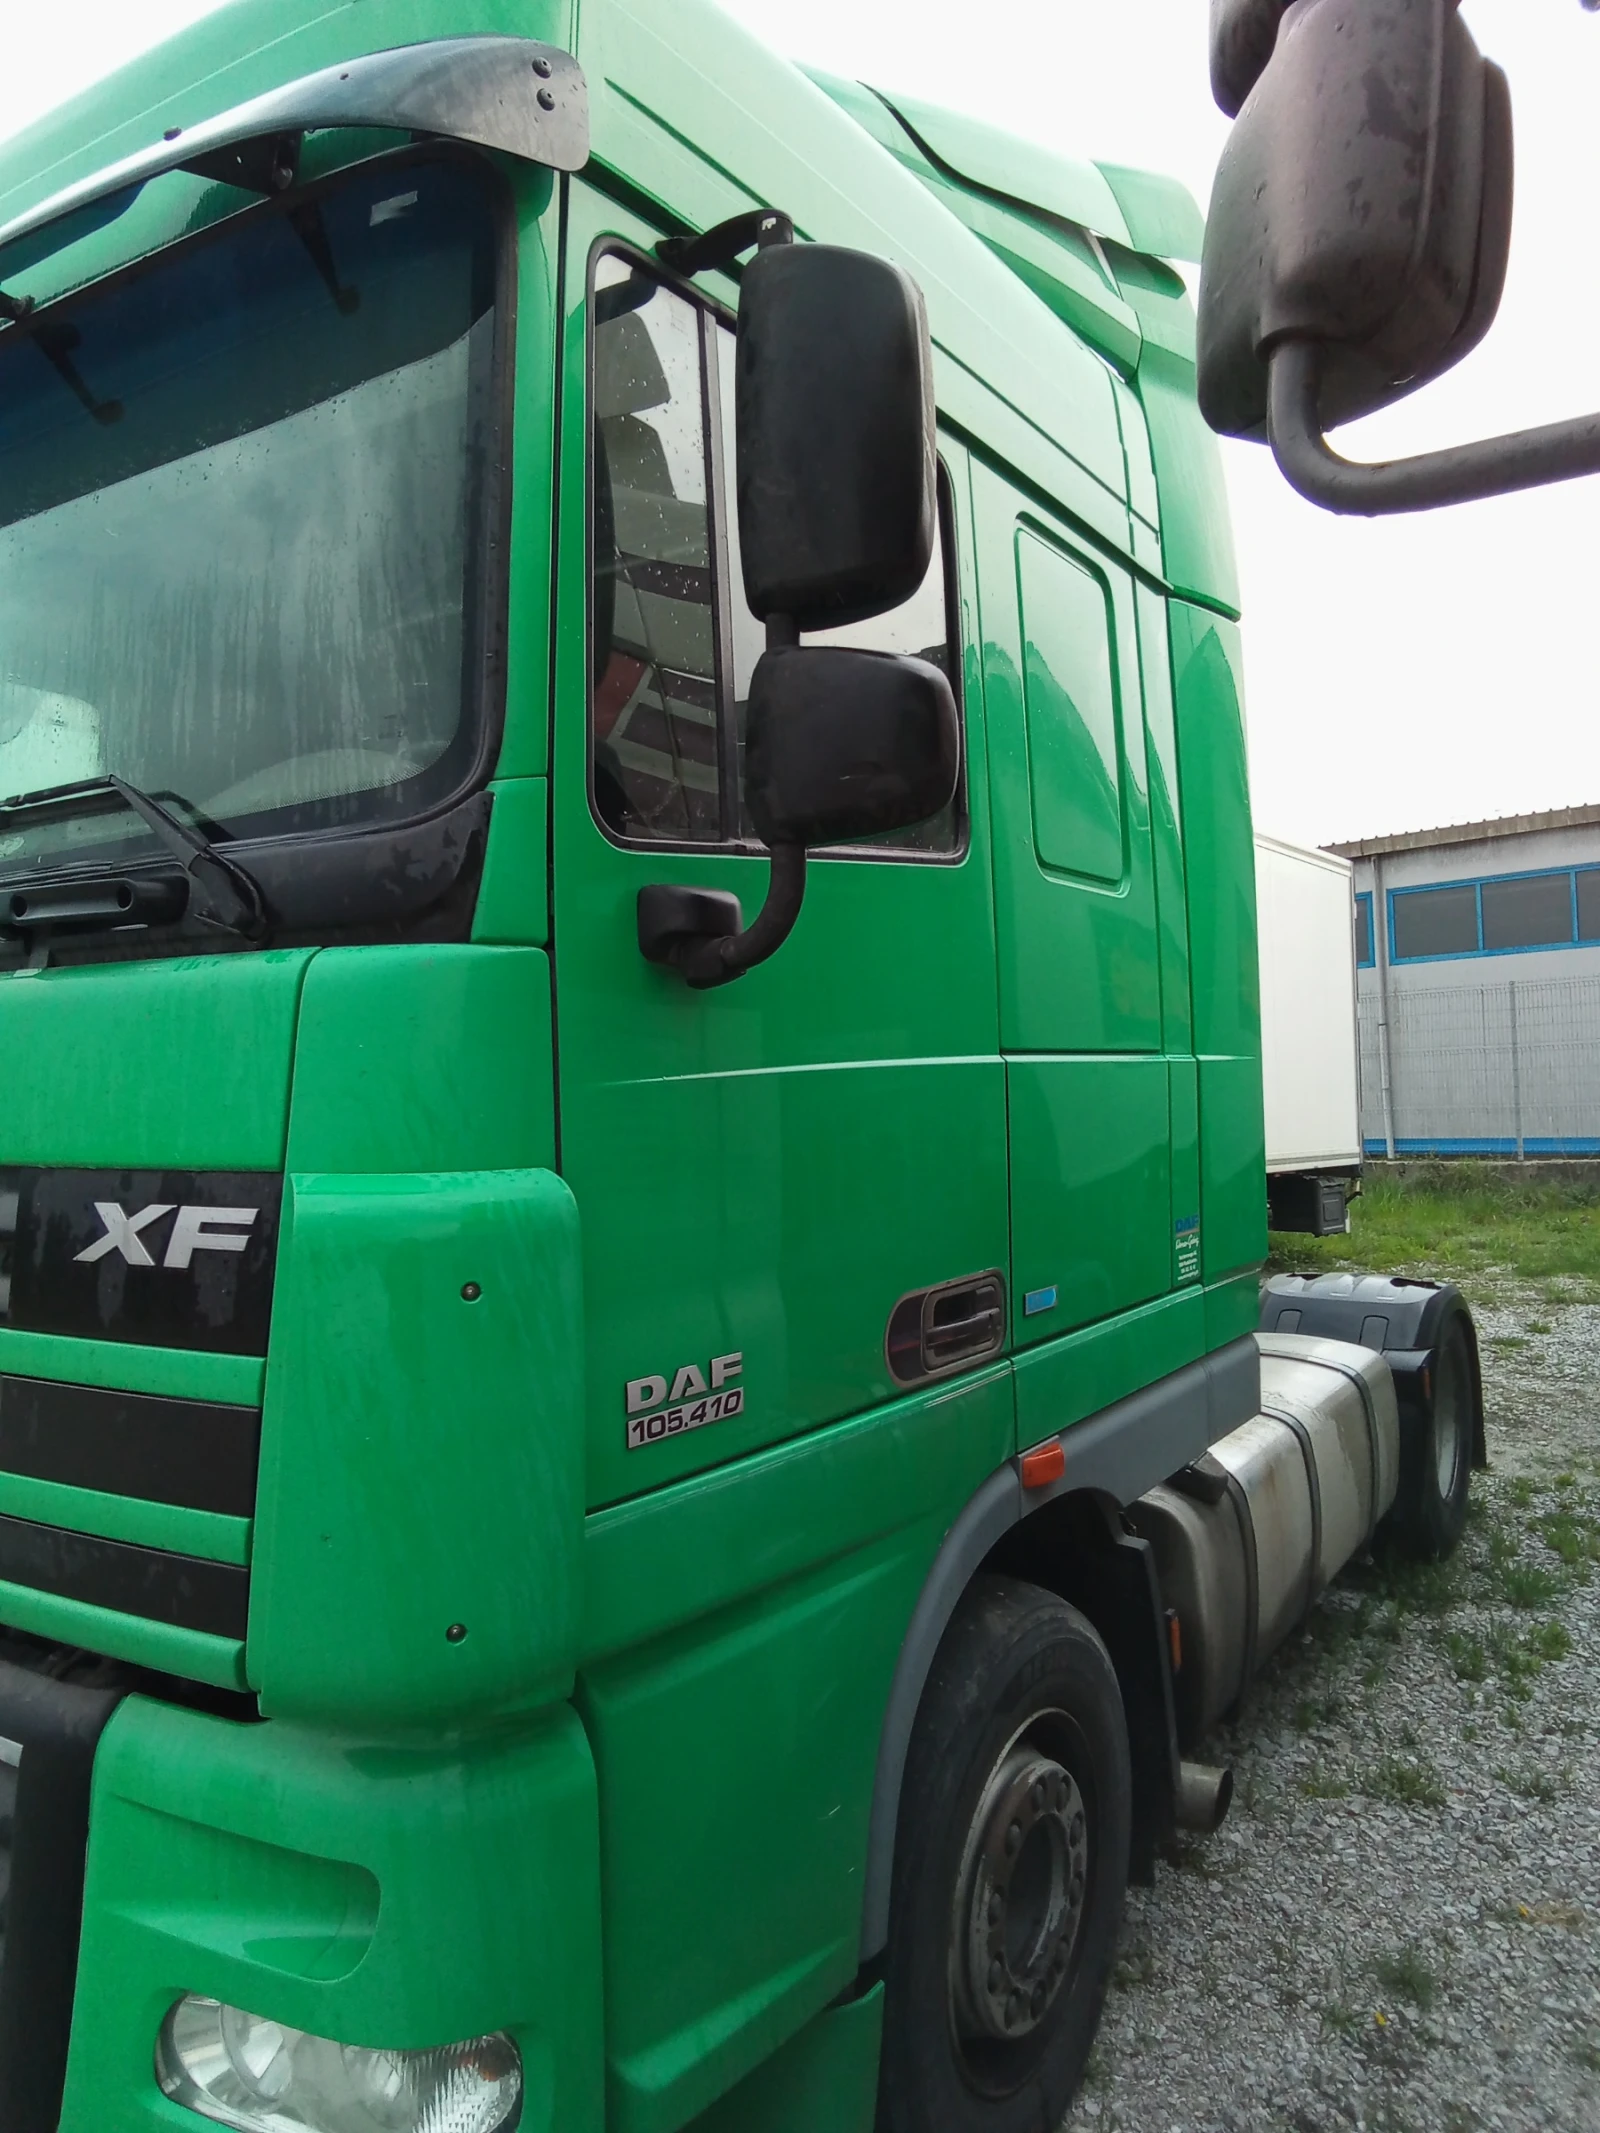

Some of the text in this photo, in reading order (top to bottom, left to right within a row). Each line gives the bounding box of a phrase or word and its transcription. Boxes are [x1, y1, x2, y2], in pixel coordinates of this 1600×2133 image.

[73, 1202, 260, 1269] XF
[626, 1351, 743, 1414] DAF
[631, 1390, 742, 1443] 105.410
